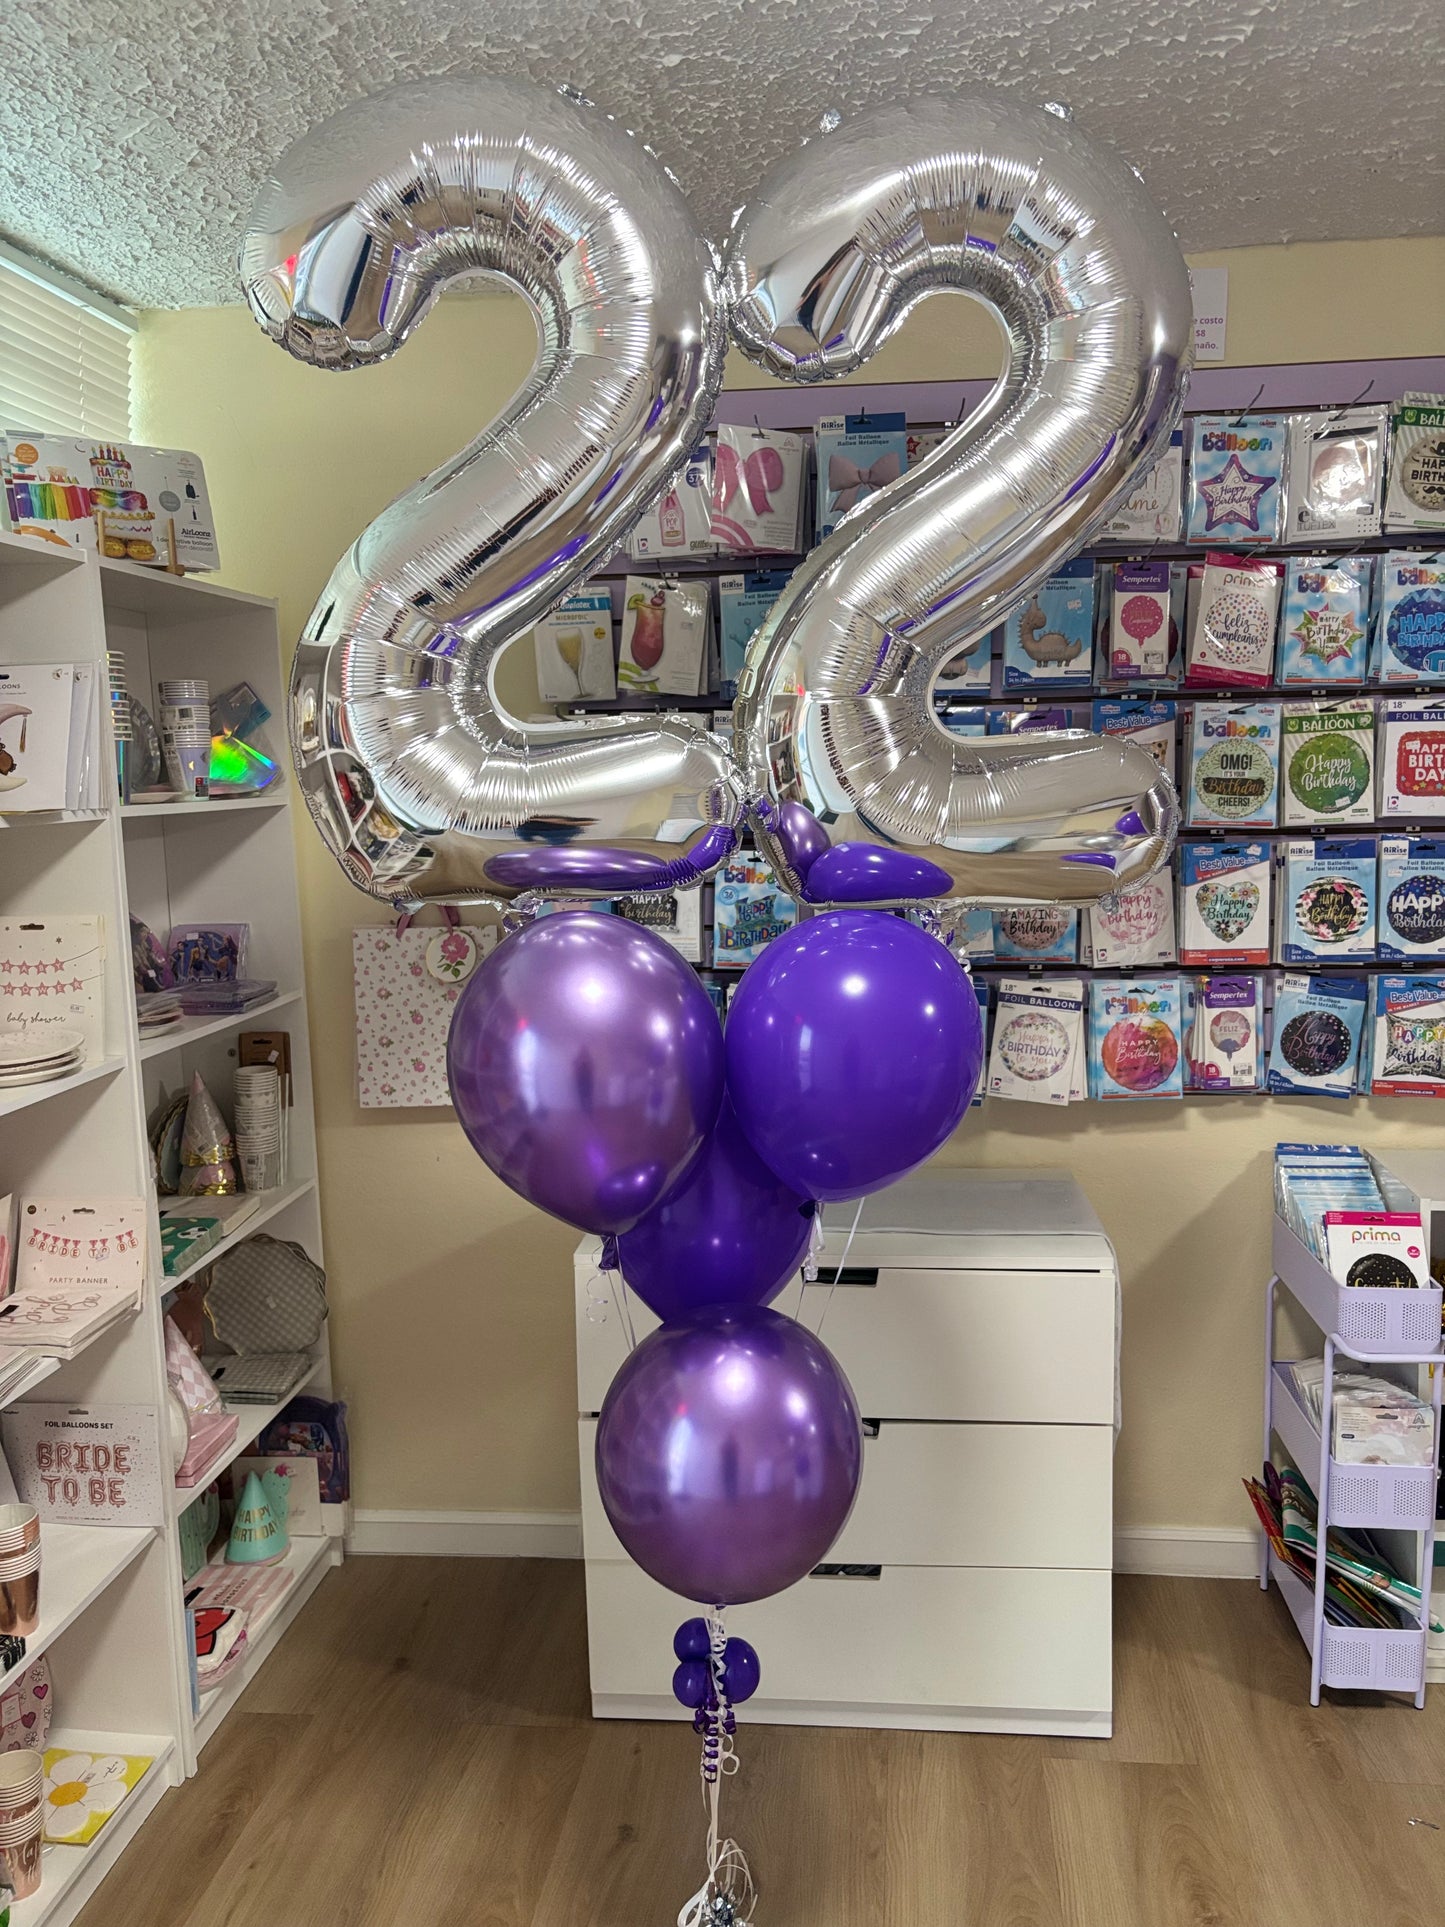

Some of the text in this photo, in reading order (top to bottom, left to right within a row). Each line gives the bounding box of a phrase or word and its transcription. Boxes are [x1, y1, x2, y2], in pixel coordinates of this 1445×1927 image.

[1200, 317, 1223, 325] costo
[821, 421, 844, 430] AiRise
[1202, 433, 1272, 451] balloon
[96, 476, 133, 489] BIRTHDAY
[1219, 484, 1247, 499] Happy
[1214, 493, 1253, 507] Birthday
[1122, 575, 1161, 585] Sempertex
[555, 613, 588, 621] MICROFOIL
[1219, 613, 1258, 633] feliz
[1117, 653, 1127, 661] 18
[1106, 715, 1151, 730] Best Value
[1395, 712, 1419, 720] FOIL
[1018, 722, 1058, 734] Sempertex
[1202, 719, 1271, 738] balloon
[1302, 719, 1355, 732] BALLOON
[1220, 753, 1253, 770] OMG!
[1305, 754, 1352, 774] Happy
[1301, 767, 1357, 791] Birthday
[1208, 778, 1265, 799] Birthday
[1217, 796, 1251, 808] CHEERS!
[1290, 846, 1314, 854] AiRise
[1383, 845, 1408, 854] AiRise
[1200, 856, 1245, 871] Best Value
[632, 894, 662, 905] HAPPY
[1210, 894, 1245, 909] Happy
[1319, 893, 1344, 905] HAPPY
[624, 901, 673, 925] birthday
[1010, 909, 1059, 920] AMAZING
[1206, 906, 1251, 920] Birthday
[1311, 905, 1353, 925] Birthday
[4, 961, 62, 974] BABY
[1285, 978, 1308, 988] AiRise
[1004, 994, 1075, 1009] FOIL BALLOON
[1209, 990, 1248, 1000] Sempertex
[1390, 990, 1439, 1003] Best Value
[7, 1011, 66, 1029] baby shower
[1219, 1025, 1239, 1033] FELIZ
[1295, 1017, 1337, 1046] Happy
[1394, 1026, 1444, 1042] HAPPY
[1019, 1030, 1053, 1047] Happy
[1120, 1039, 1159, 1047] HAPPY
[1007, 1041, 1062, 1058] BIRTHDAY
[1116, 1046, 1162, 1065] Birthday
[1352, 1227, 1401, 1243] prima
[29, 1237, 78, 1256] BRIDE
[119, 1239, 137, 1252] BE
[44, 1420, 113, 1430] FOIL BALLOONS SET
[37, 1441, 131, 1475] BRIDE
[40, 1474, 126, 1508] TO BE
[237, 1503, 271, 1525] HAPPY
[232, 1521, 278, 1543] BIRTHDAY
